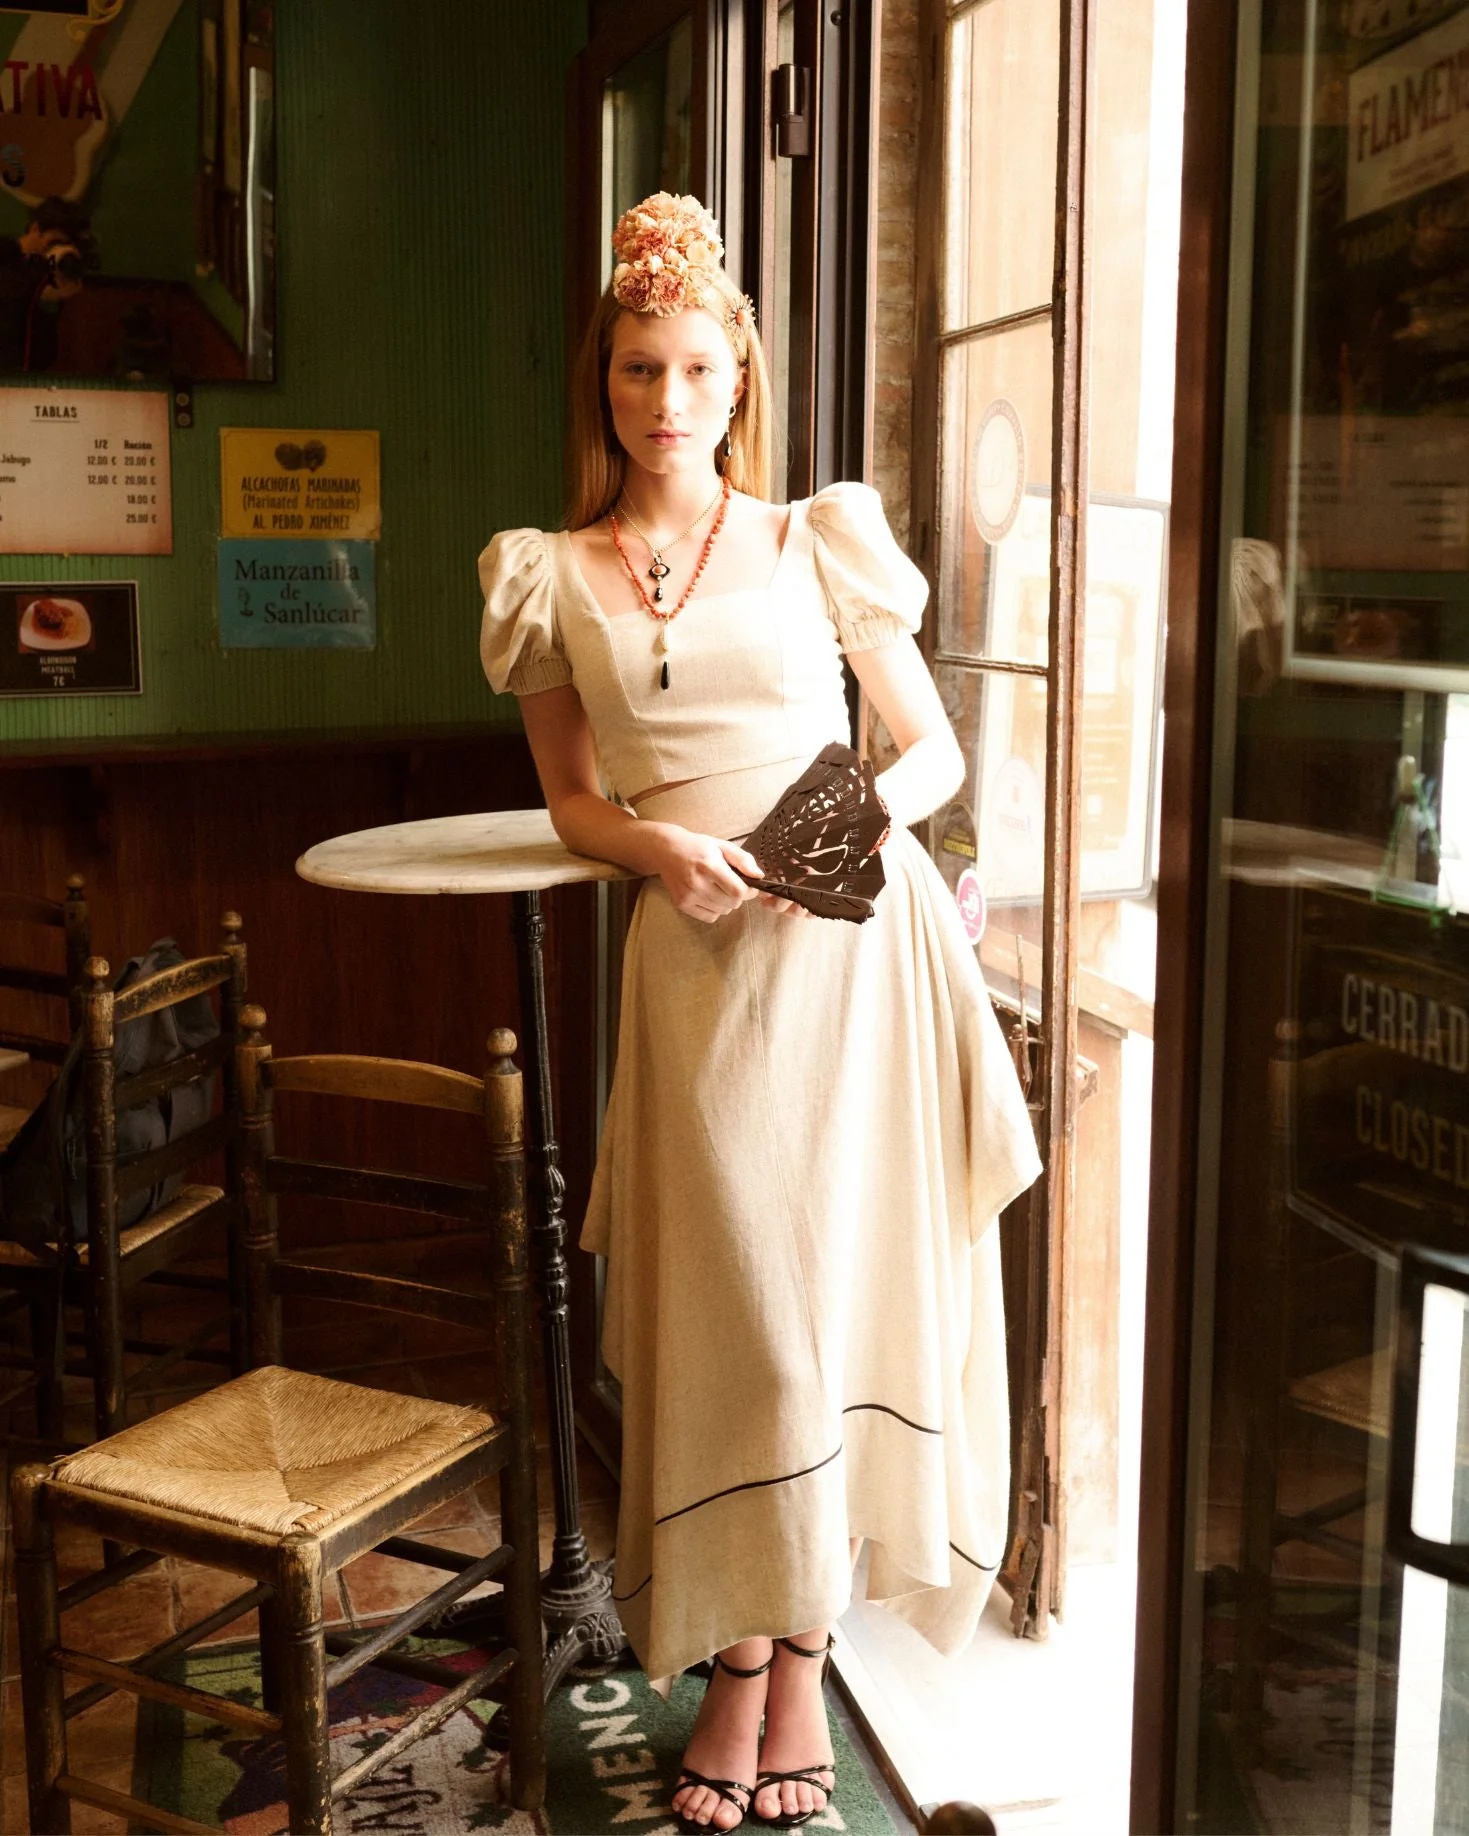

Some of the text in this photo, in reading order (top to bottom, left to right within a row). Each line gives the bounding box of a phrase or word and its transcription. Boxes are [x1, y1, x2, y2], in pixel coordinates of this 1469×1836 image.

[0, 61, 102, 120] TIVA
[34, 405, 78, 418] TABLAS
[94, 439, 109, 450] 1/2
[241, 477, 361, 493] ALCACHOFAS MARINADAS
[243, 495, 360, 512] (Marinated Artichokes)
[252, 514, 266, 529] AL
[272, 514, 303, 530] PEDRO
[235, 559, 360, 582] Manzanilla
[280, 583, 301, 600] de
[264, 602, 361, 623] Sanlúcar
[1356, 1084, 1469, 1190] CLOSED
